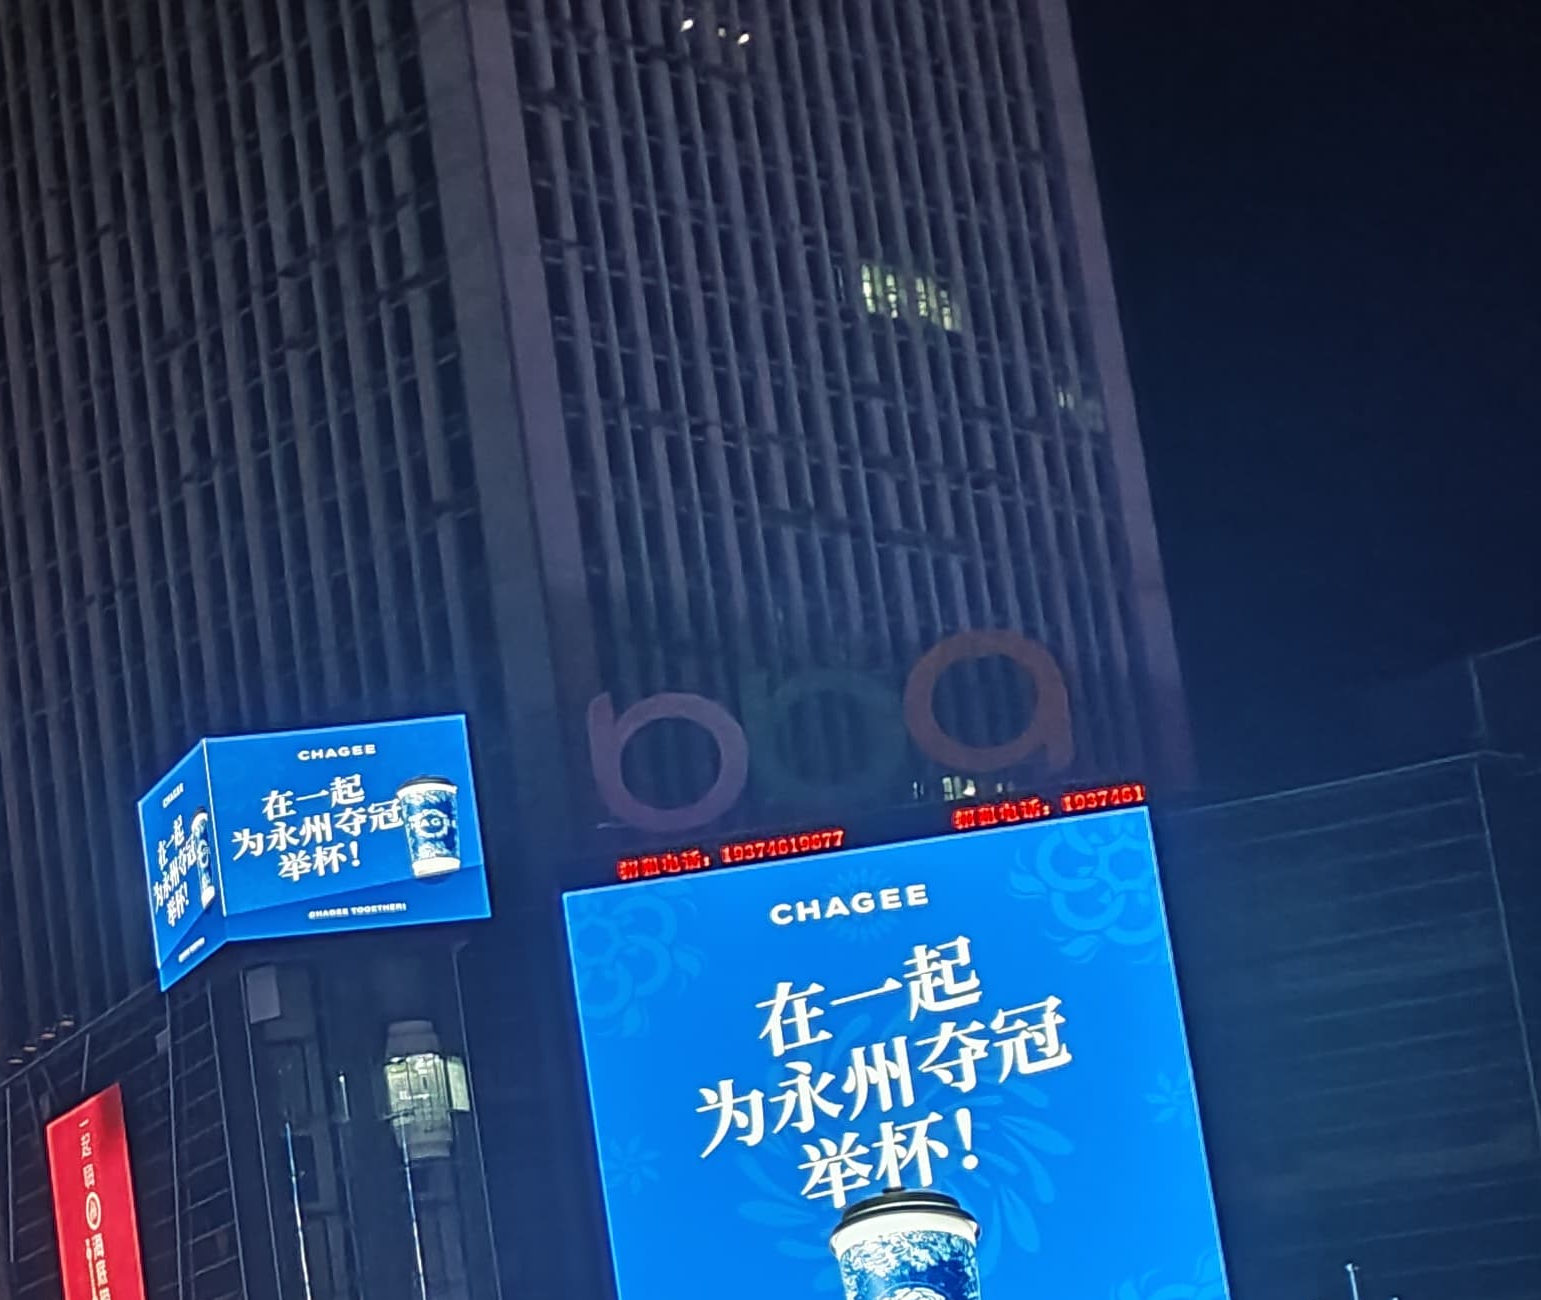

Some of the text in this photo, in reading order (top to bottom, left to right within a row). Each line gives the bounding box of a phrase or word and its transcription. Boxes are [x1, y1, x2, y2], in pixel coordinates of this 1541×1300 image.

[297, 744, 377, 761] CHAGEE
[261, 774, 366, 822] 在一起
[231, 799, 405, 860] 为永州夺冠
[278, 841, 361, 883] 举杯!
[770, 884, 930, 926] CHAGEE
[755, 935, 984, 1059] 在一起
[695, 995, 1073, 1159] 为永州夺冠
[798, 1107, 980, 1209] 举杯!
